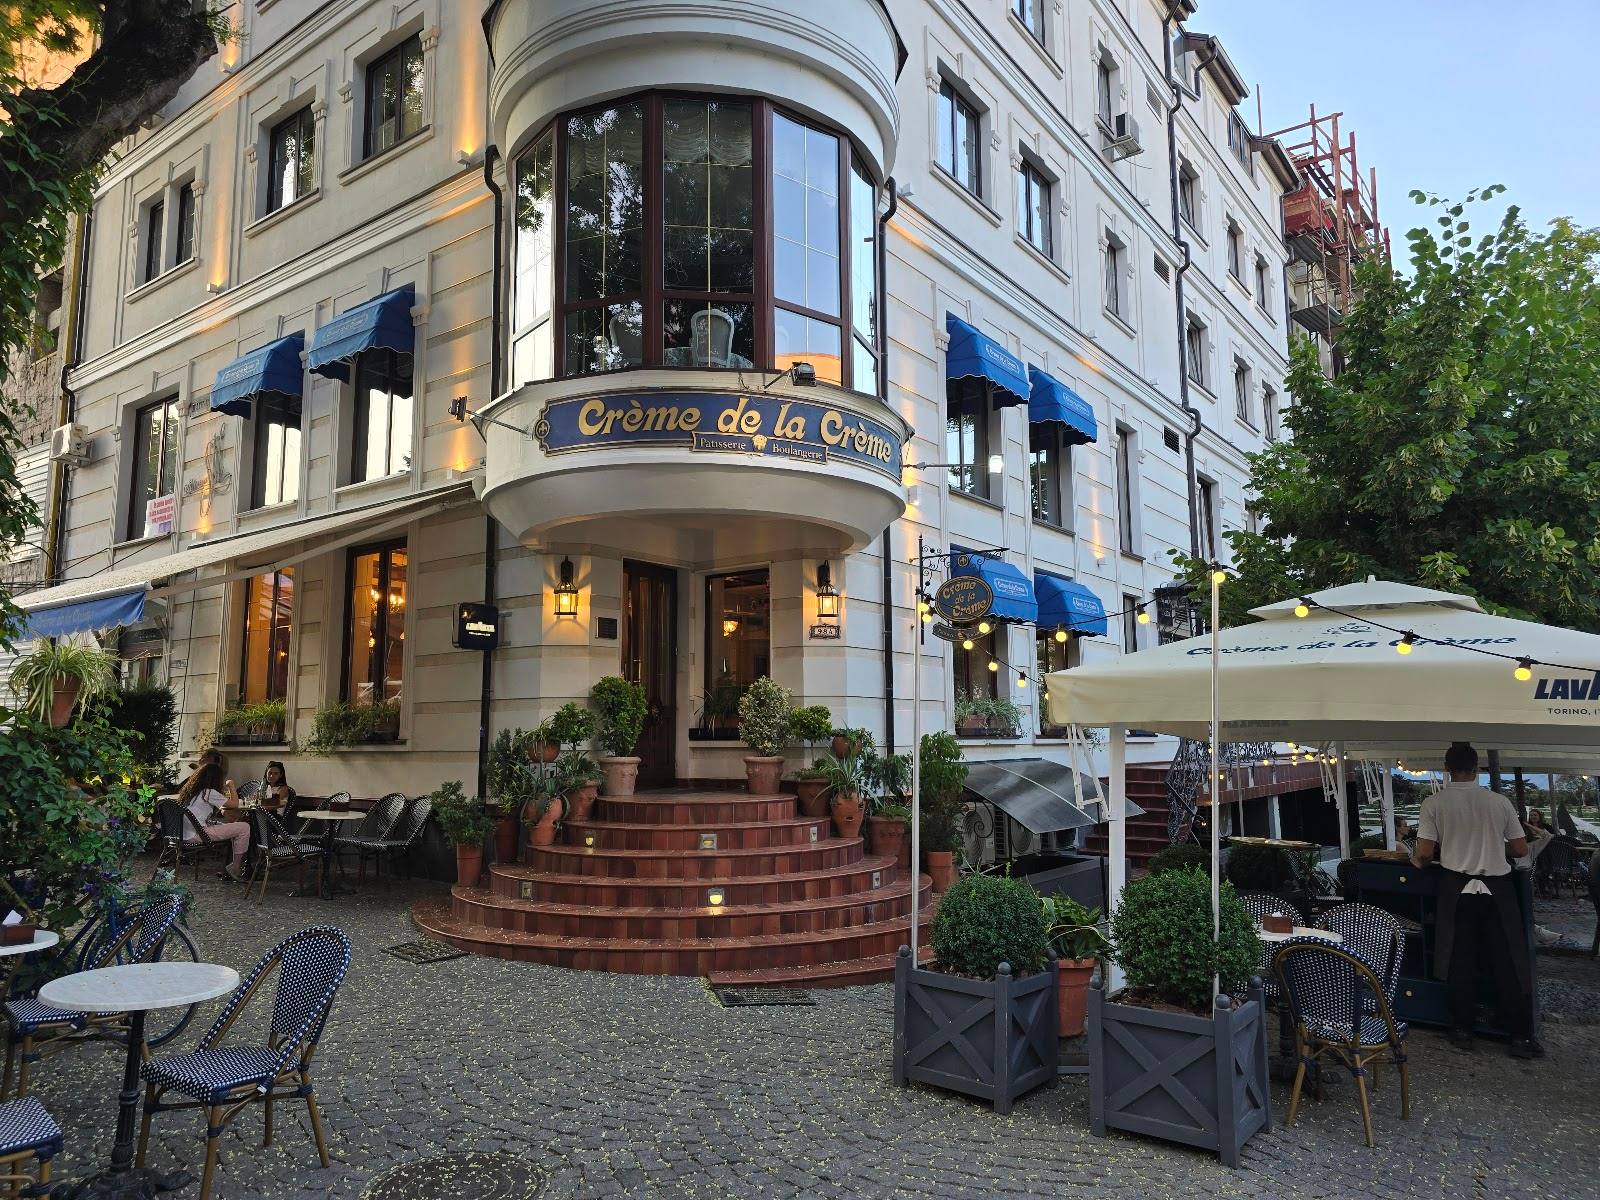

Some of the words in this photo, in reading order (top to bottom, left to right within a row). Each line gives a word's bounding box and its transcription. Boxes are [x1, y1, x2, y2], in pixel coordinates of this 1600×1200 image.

[578, 400, 701, 436] Crème
[717, 397, 762, 434] de
[774, 403, 806, 439] la
[820, 410, 892, 463] Crème
[700, 437, 747, 450] Patisserie
[772, 443, 823, 460] Boulangerie
[1547, 707, 1592, 716] TORINO,
